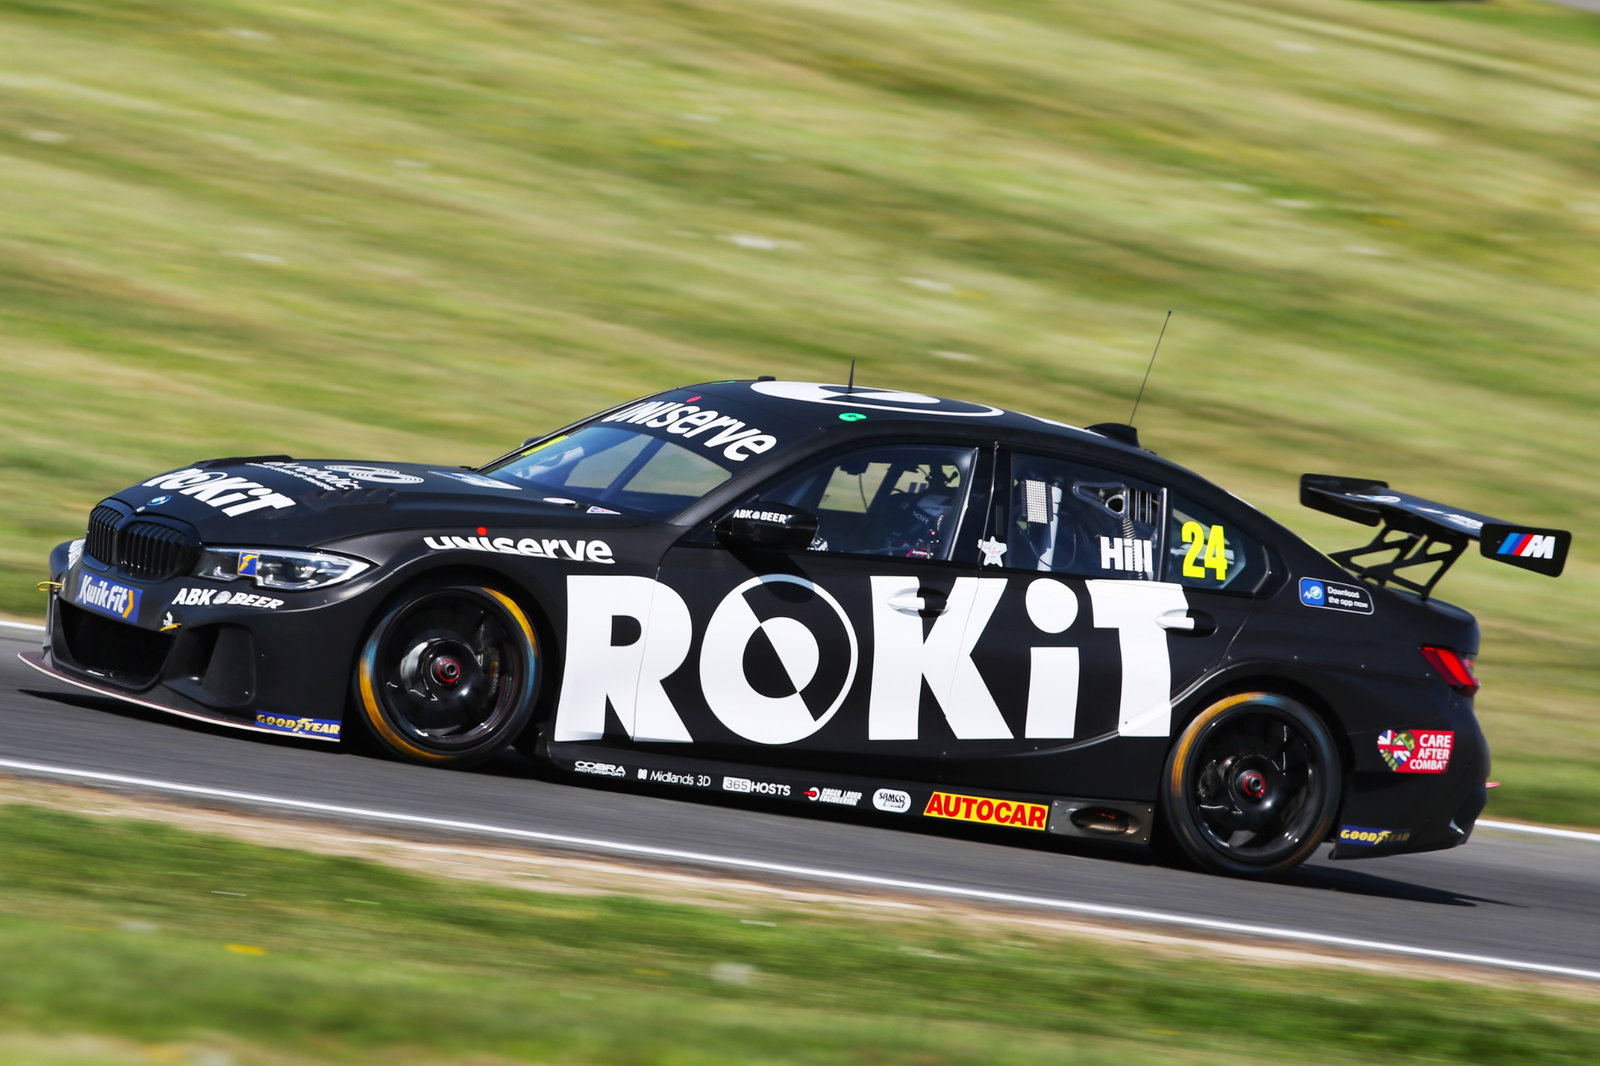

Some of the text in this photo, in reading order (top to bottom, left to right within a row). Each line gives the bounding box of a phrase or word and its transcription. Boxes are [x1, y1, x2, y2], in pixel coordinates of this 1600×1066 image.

[601, 396, 777, 462] uniserve
[733, 508, 787, 525] ABK BEER
[424, 527, 616, 564] uniserve
[1099, 536, 1153, 573] Hill
[1182, 520, 1229, 581] 24
[171, 587, 284, 610] ABK BEER
[1327, 586, 1360, 597] Download
[1328, 596, 1340, 605] the
[1340, 599, 1354, 607] app
[554, 574, 1196, 744] ROKiT
[255, 714, 340, 735] GOODYEAR
[1419, 734, 1452, 748] CARE
[1417, 748, 1450, 760] AFTER
[574, 760, 626, 773] COBRA
[574, 767, 626, 778] MOTORSPORT
[1409, 759, 1449, 771] COMBAT
[649, 769, 712, 787] Midlands 3D
[925, 793, 1046, 828] AUTOCAR
